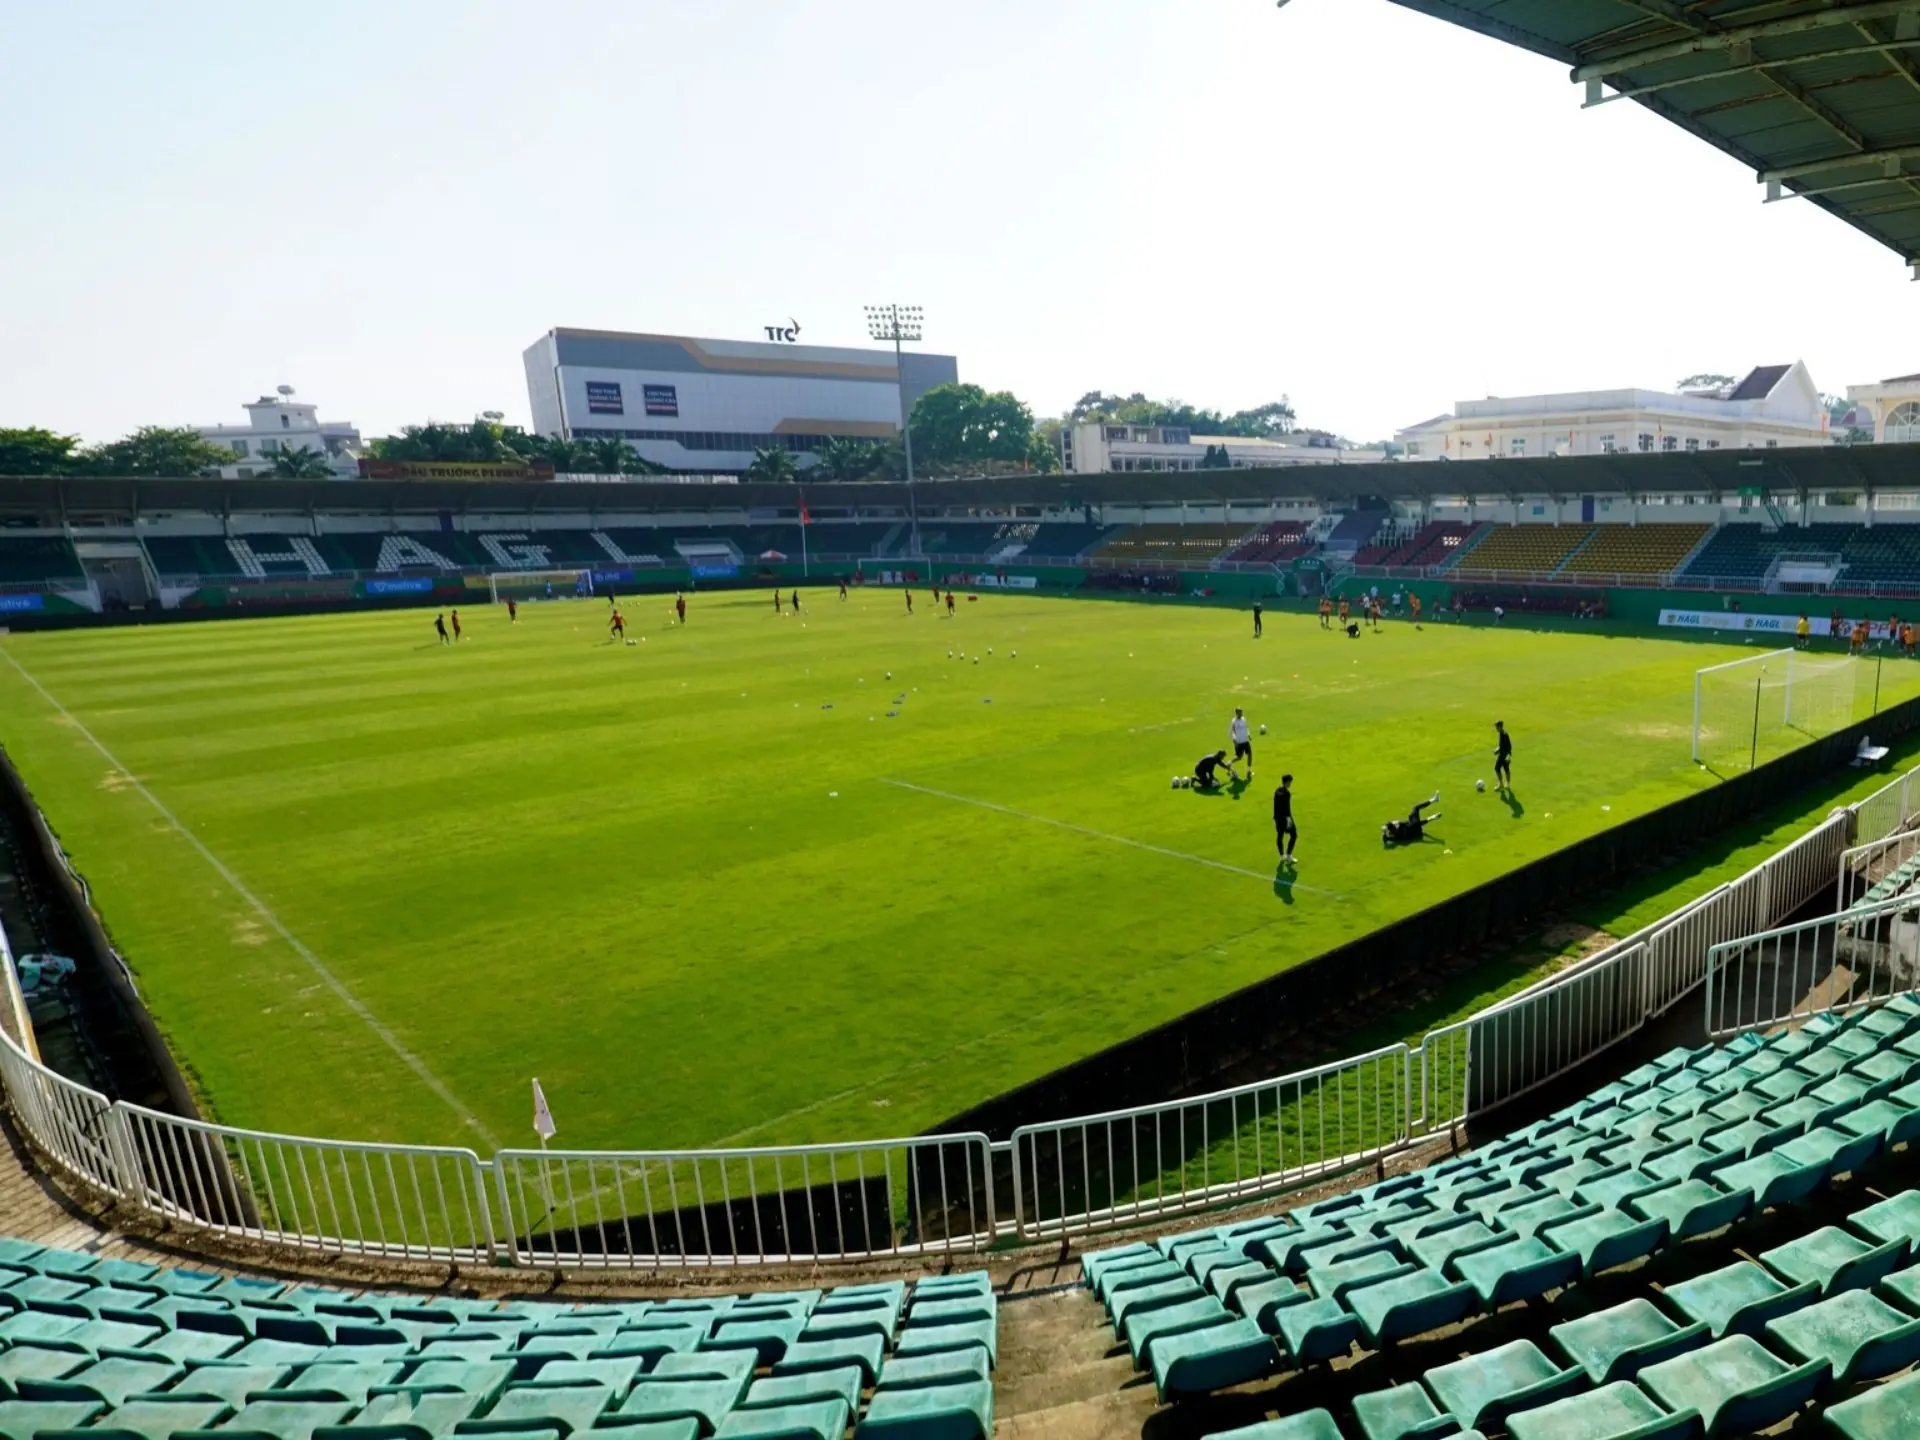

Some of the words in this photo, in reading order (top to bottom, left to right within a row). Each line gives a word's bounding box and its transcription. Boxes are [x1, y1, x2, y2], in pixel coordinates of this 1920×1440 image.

[764, 325, 797, 342] TTC
[225, 531, 661, 578] HAGL
[1676, 613, 1701, 625] HAGL
[1754, 619, 1781, 629] HAGL
